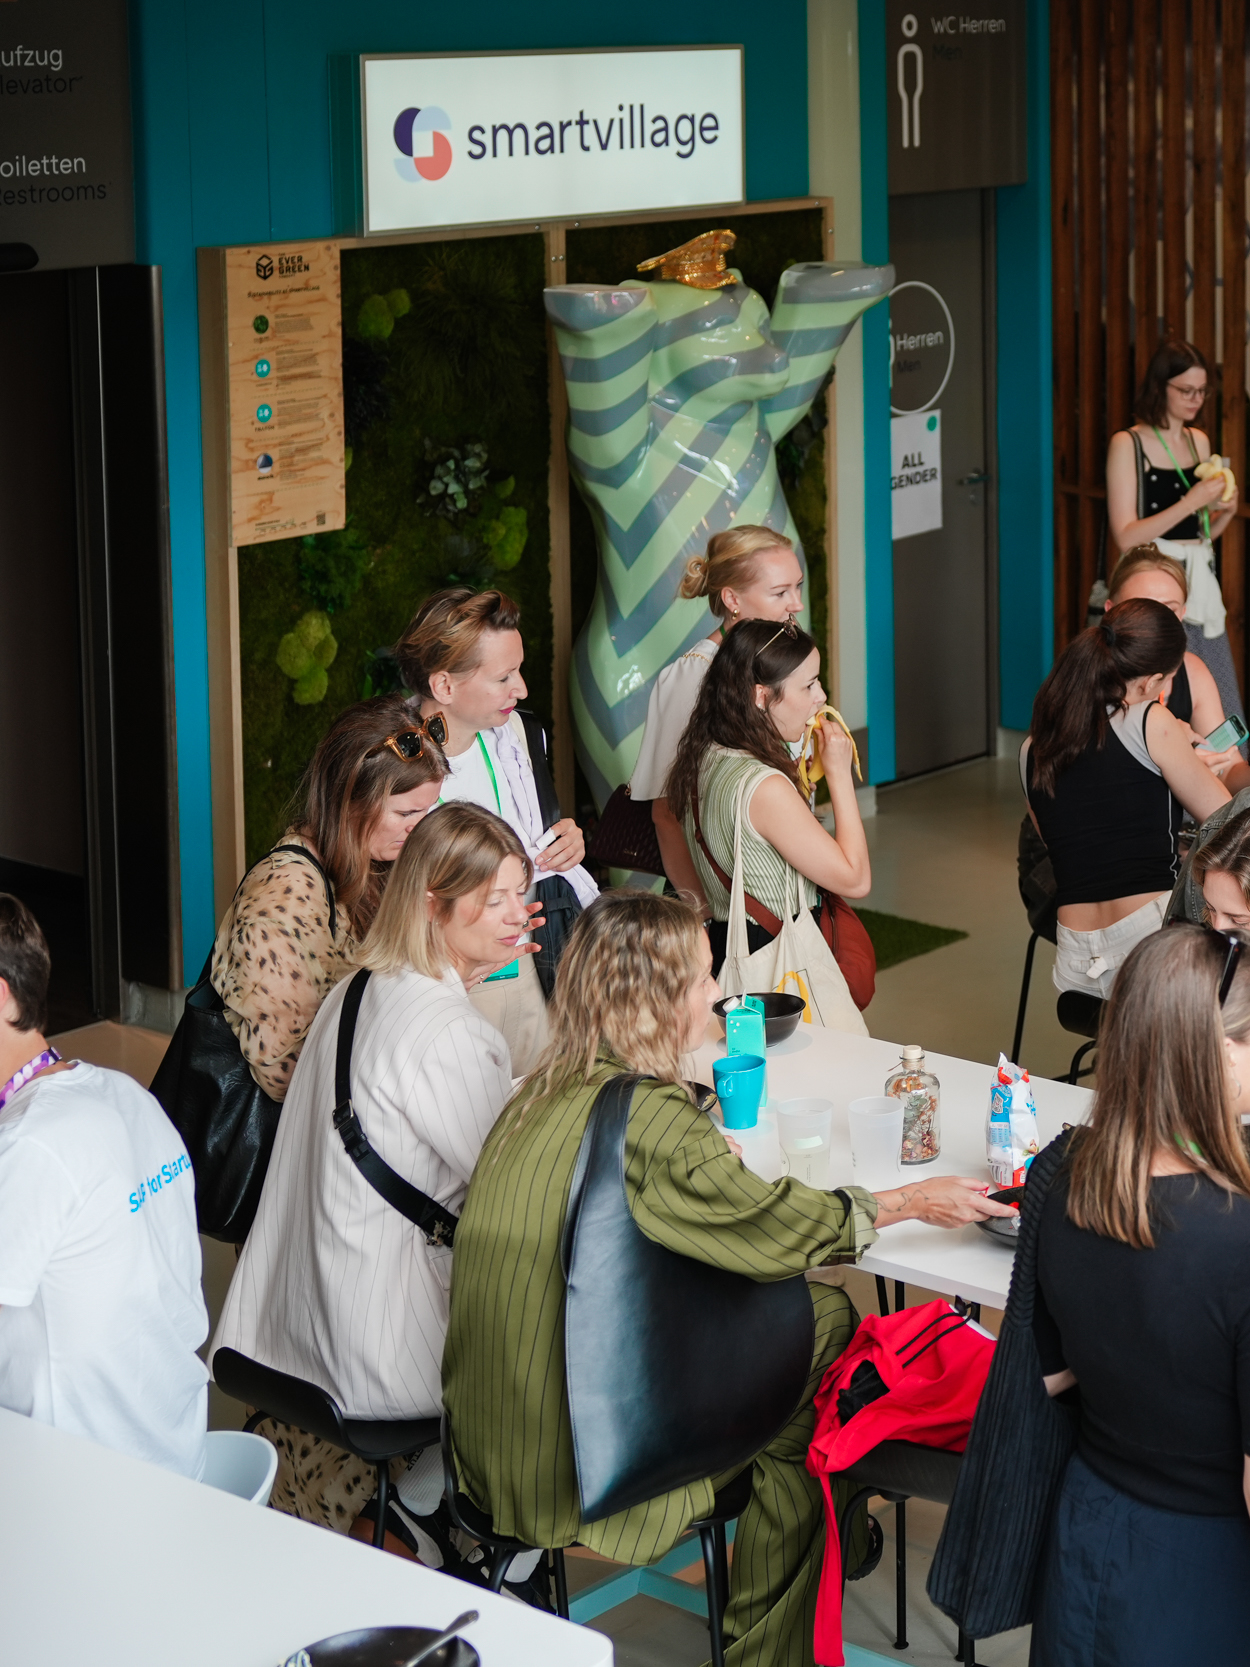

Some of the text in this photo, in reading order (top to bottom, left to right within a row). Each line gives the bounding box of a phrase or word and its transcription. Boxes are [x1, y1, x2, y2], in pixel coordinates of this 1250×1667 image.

[930, 15, 1006, 34] WC Herren
[0, 44, 64, 72] ufzug
[0, 74, 78, 96] levator
[466, 102, 719, 160] smartvillage
[0, 154, 87, 178] oiletten
[0, 182, 107, 206] estrooms
[278, 255, 303, 265] EVER
[278, 264, 310, 275] GREEN
[896, 331, 944, 351] Herren
[902, 452, 925, 469] ALL
